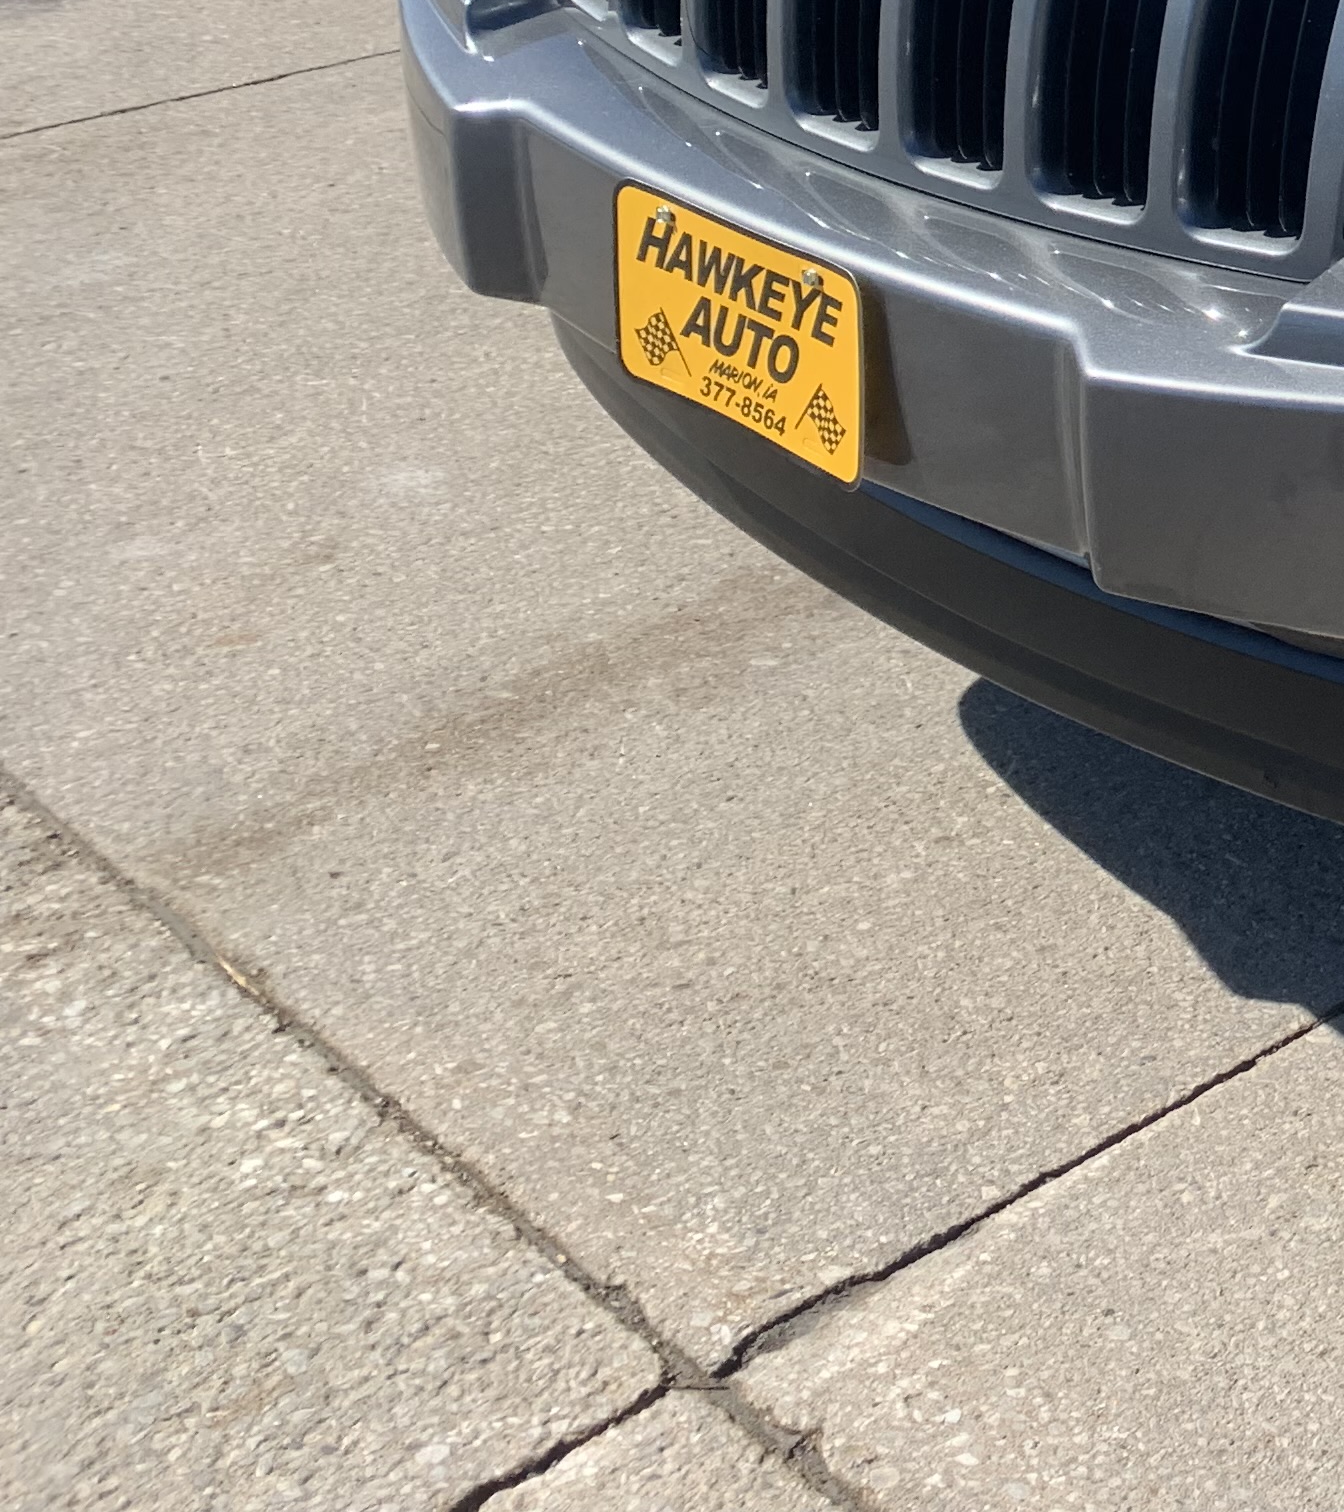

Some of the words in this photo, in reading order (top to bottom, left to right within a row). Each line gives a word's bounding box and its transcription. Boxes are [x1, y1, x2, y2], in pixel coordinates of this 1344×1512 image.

[637, 217, 843, 347] HAWKEYE
[680, 296, 800, 384] AUTO
[700, 376, 787, 436] 377-8564
